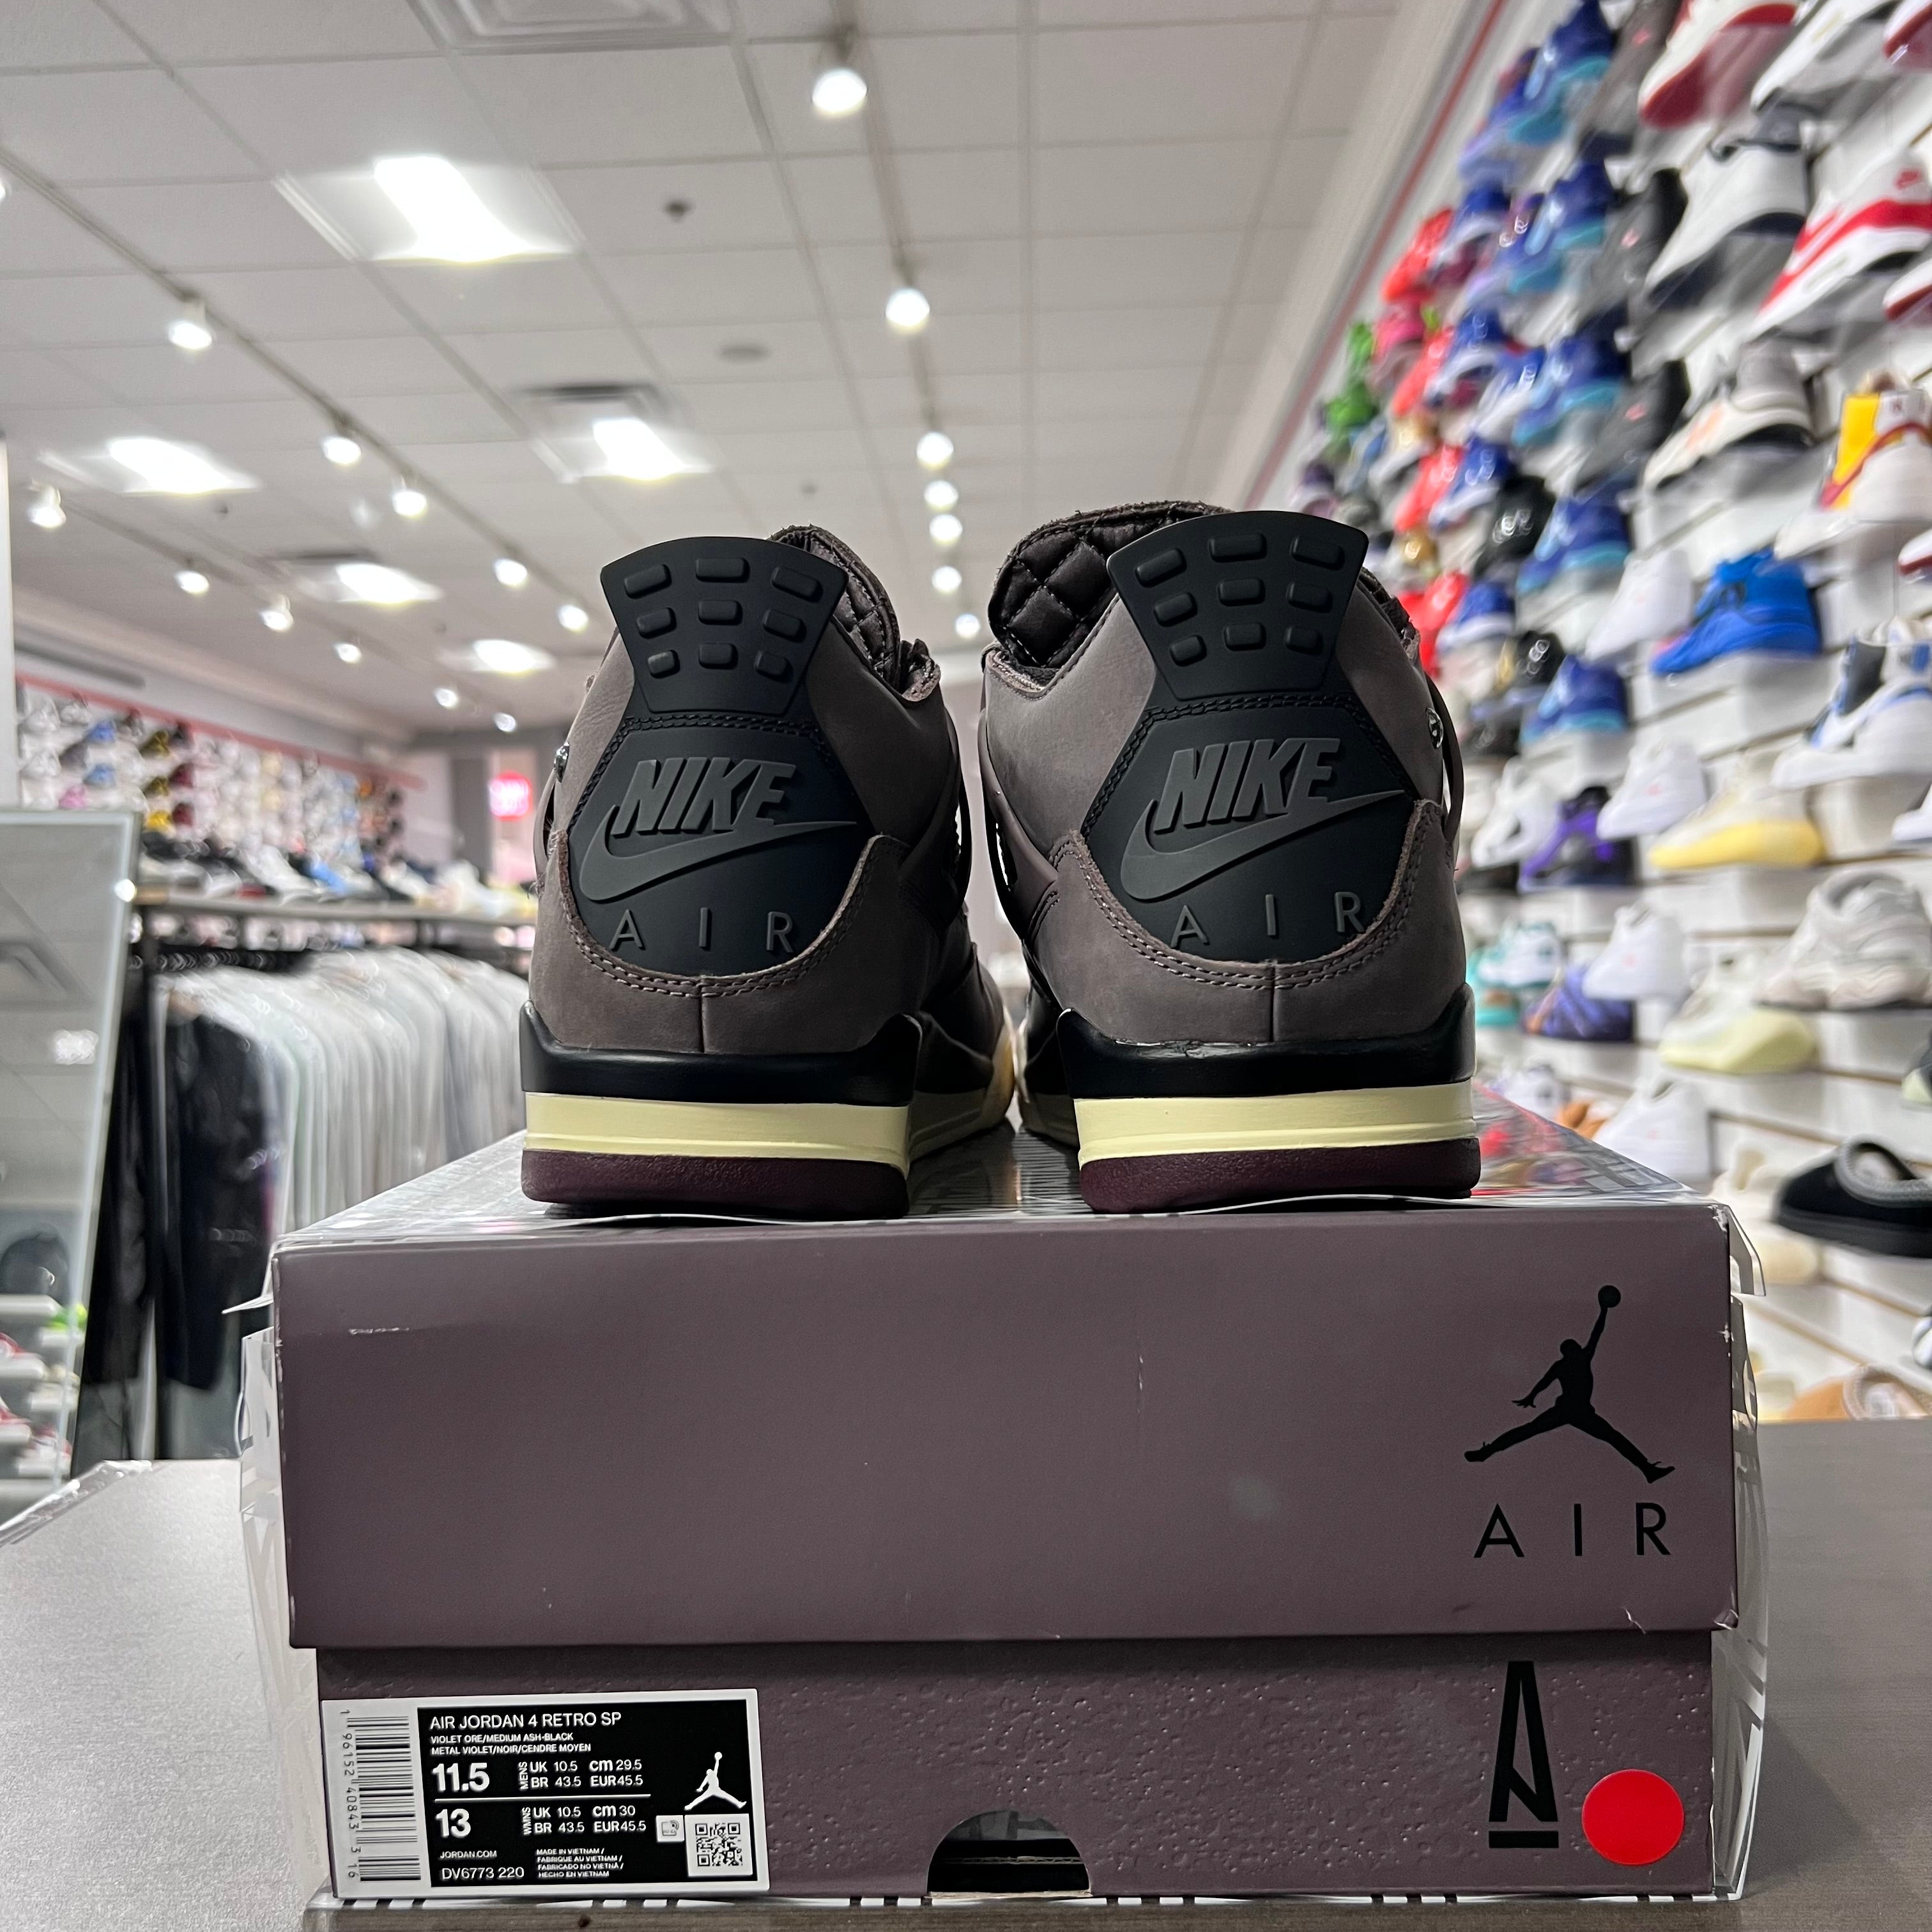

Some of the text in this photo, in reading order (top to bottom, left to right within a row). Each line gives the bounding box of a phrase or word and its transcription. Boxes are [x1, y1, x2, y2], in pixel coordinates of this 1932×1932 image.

[611, 757, 797, 838] NIKE
[1154, 738, 1340, 834] NIKE
[610, 907, 794, 953] AIR
[1170, 892, 1366, 949] AIR
[1473, 1502, 1671, 1558] AIR
[429, 1712, 622, 1729] AIR JORDAN 4 RETRO SP
[431, 1732, 574, 1744] VIOLET ORE/MEDIUM ASH-BLACK
[431, 1743, 592, 1755] METAL VIOLET/NOIR/CENDRE MOYEN
[342, 1733, 355, 1776] 96152
[530, 1759, 642, 1773] UK 10.5 cm 29.5
[431, 1762, 490, 1793] 11.5
[518, 1761, 529, 1791] MENS
[531, 1776, 549, 1788] BR
[555, 1776, 581, 1787] 43.5
[346, 1786, 359, 1830] 40843
[522, 1807, 532, 1836] WMNS
[532, 1805, 636, 1818] UK 10.5 cm 30
[435, 1808, 471, 1839] 13
[534, 1822, 552, 1834] BR
[558, 1821, 585, 1833] 43.5
[441, 1866, 525, 1880] DV6773 220
